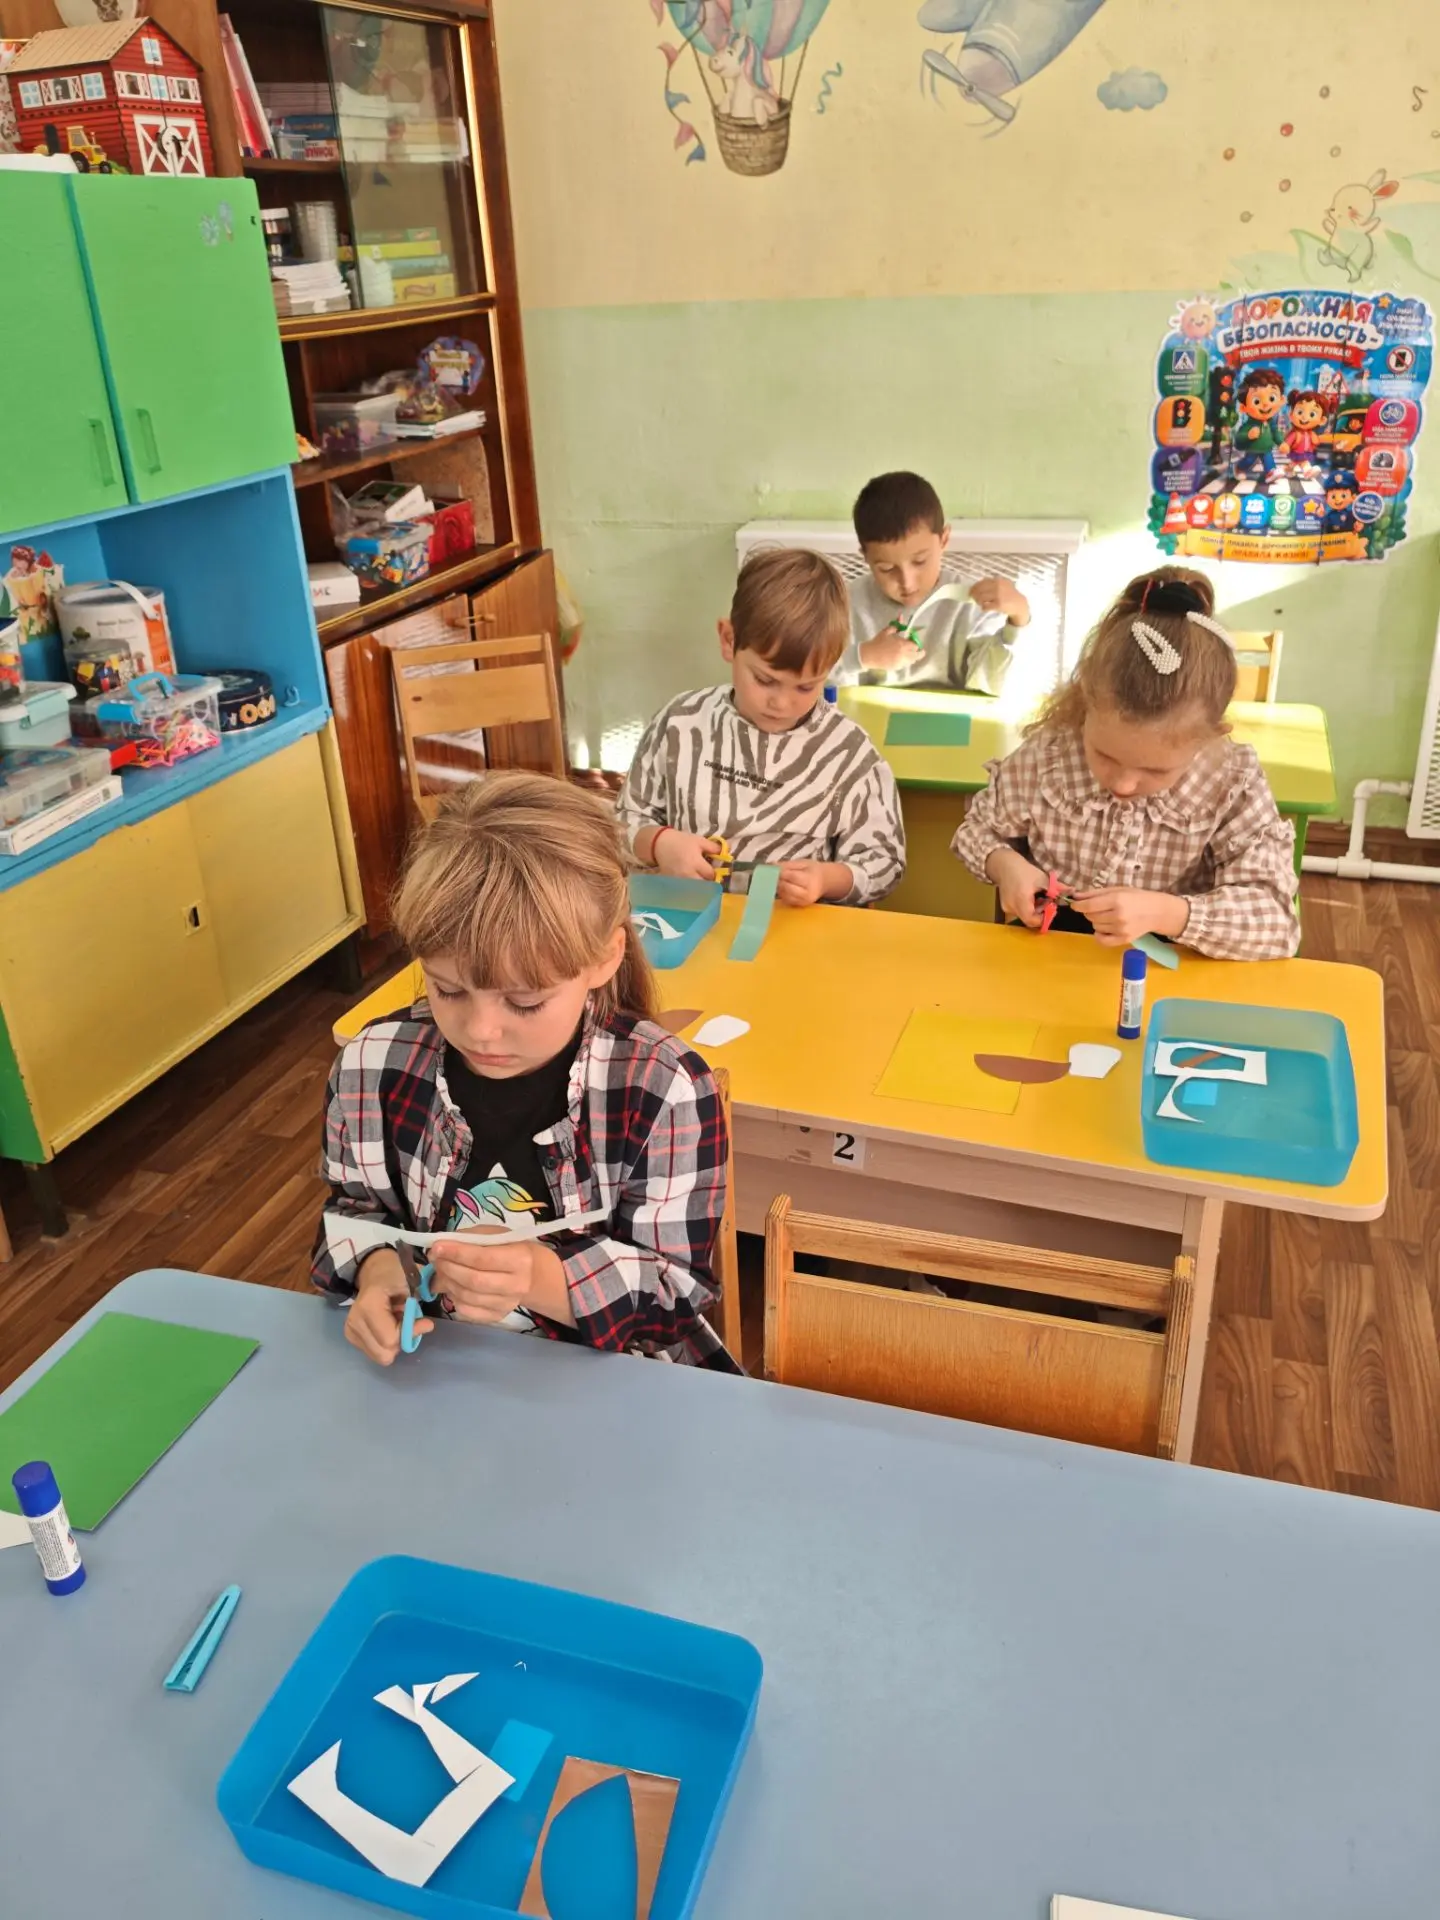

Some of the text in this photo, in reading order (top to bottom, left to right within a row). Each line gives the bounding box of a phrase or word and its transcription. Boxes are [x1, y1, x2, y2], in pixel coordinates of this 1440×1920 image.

[1232, 297, 1372, 325] ДОРОЖНАЯ
[1223, 321, 1367, 347] БЕЗОПАСНОСТЬ
[834, 1132, 855, 1161] 2
